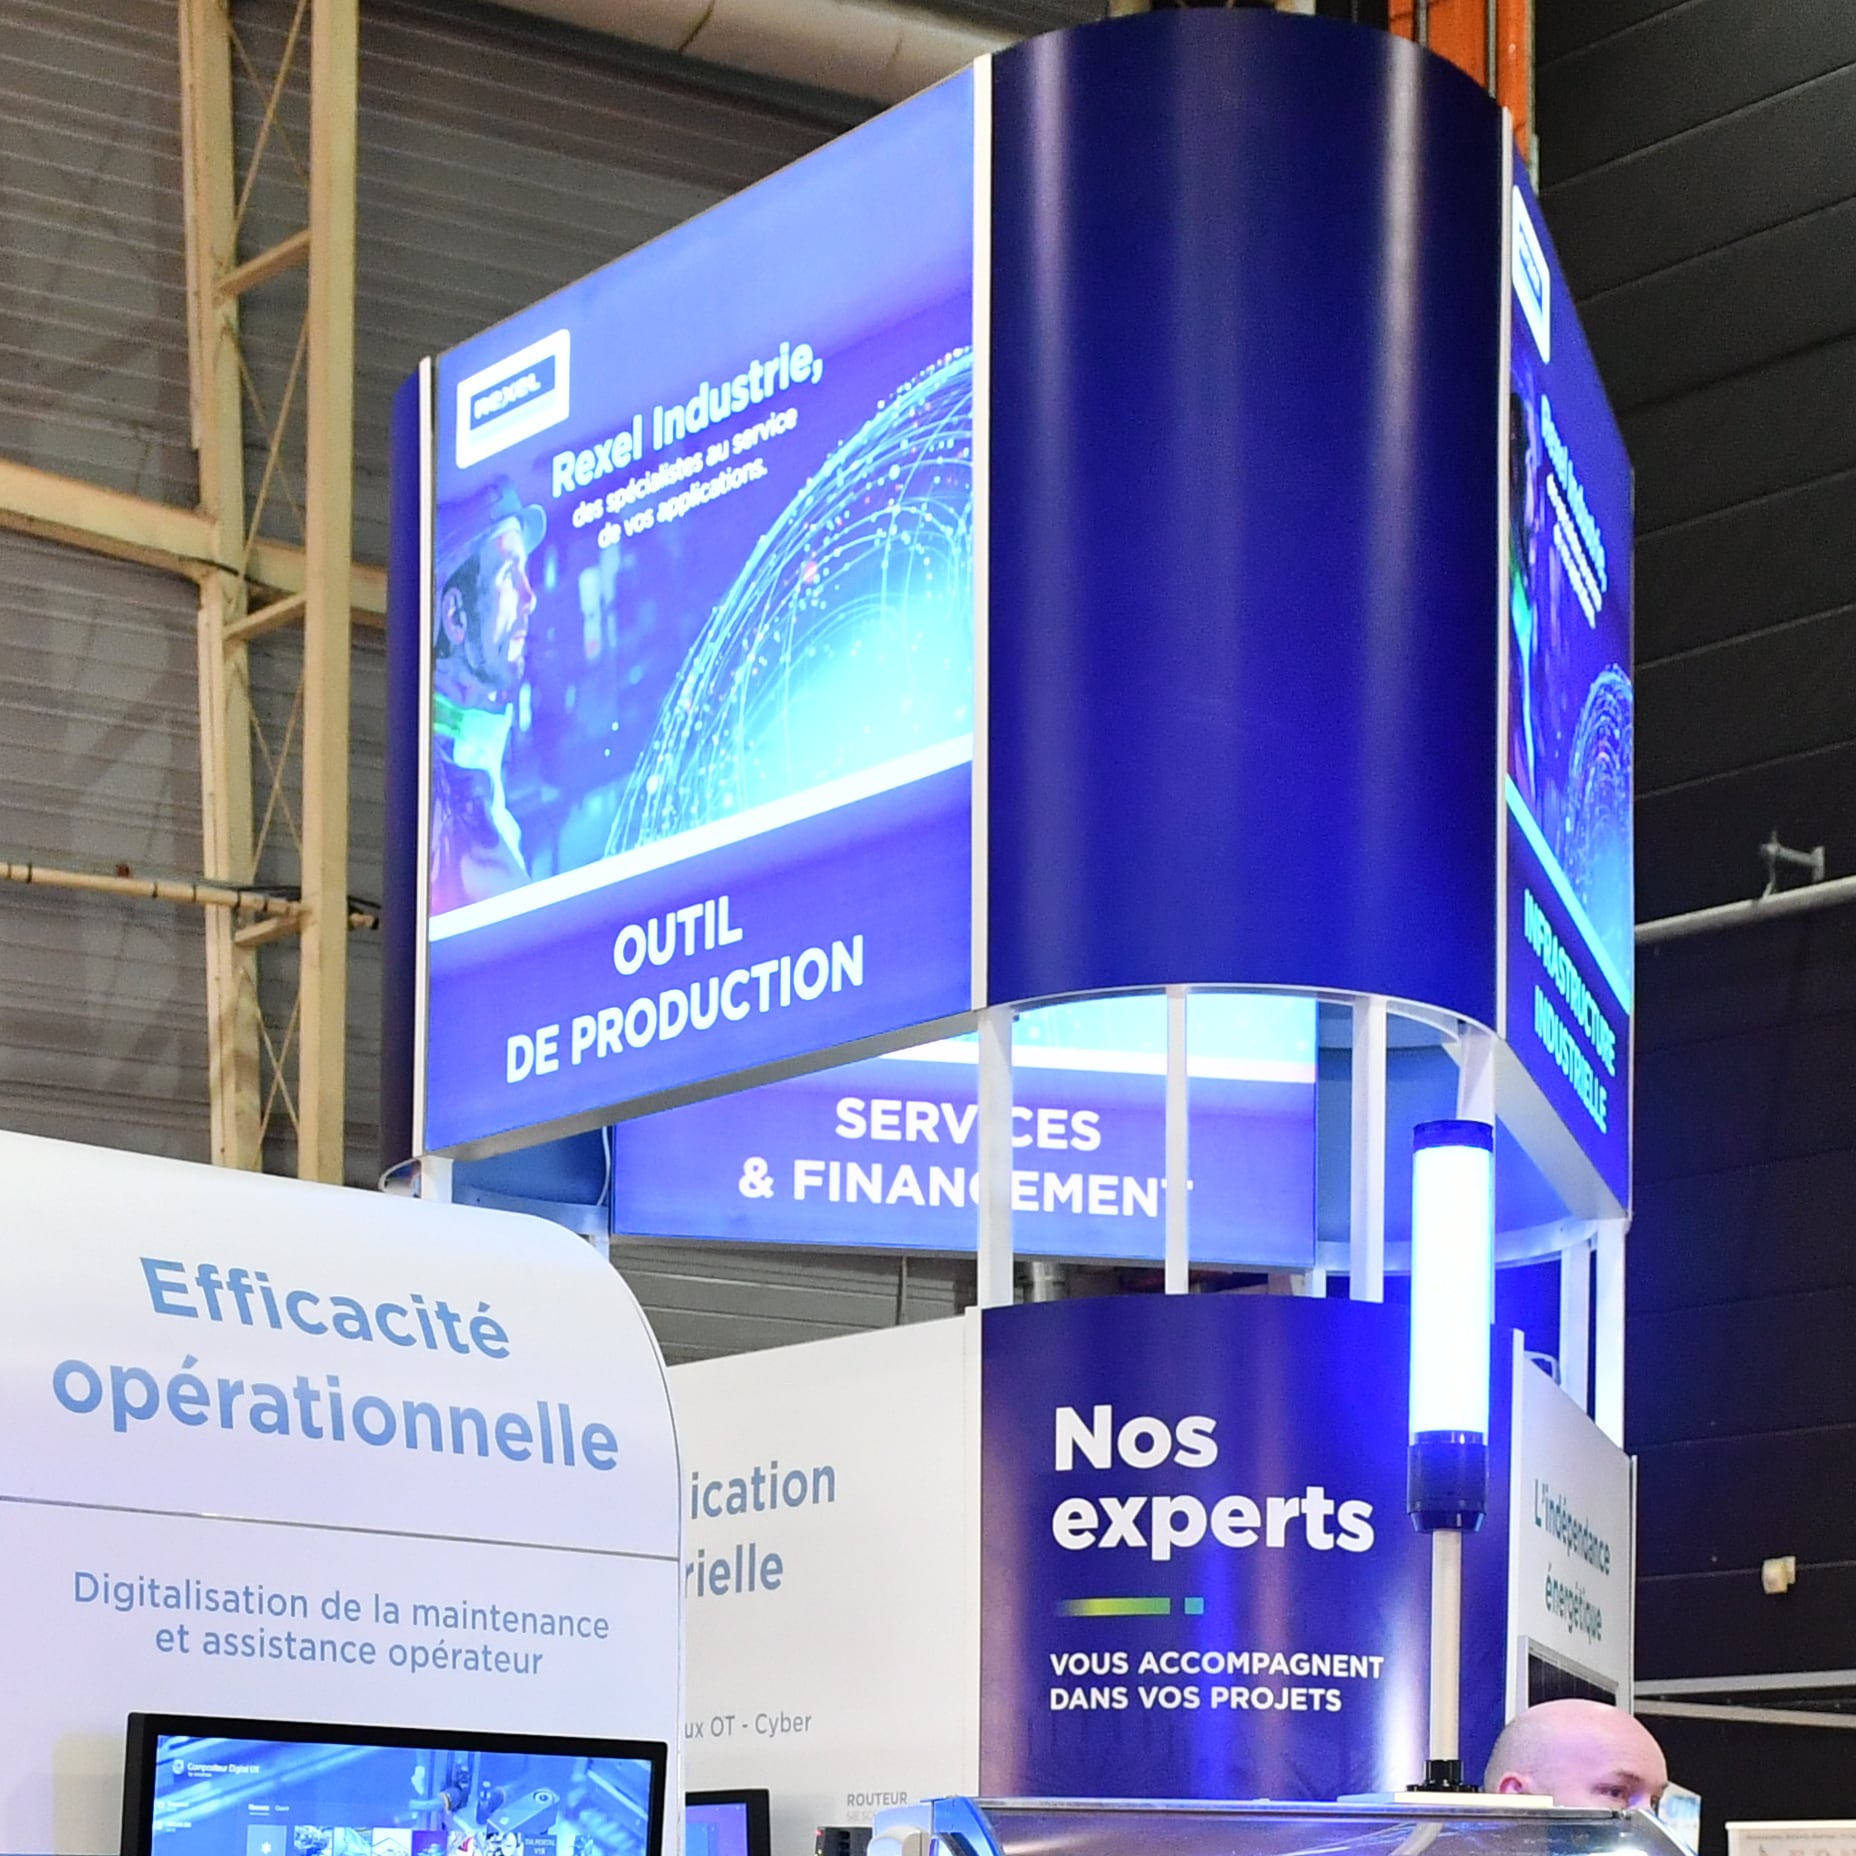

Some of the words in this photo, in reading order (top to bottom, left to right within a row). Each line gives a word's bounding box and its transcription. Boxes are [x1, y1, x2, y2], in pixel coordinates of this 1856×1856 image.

[552, 415, 642, 498] Rexel
[652, 341, 824, 450] Industrie,
[572, 496, 604, 528] des
[606, 452, 704, 515] spécialistes
[706, 440, 731, 467] au
[732, 408, 799, 455] service
[597, 521, 622, 549] de
[623, 506, 655, 538] vos
[656, 456, 768, 523] applications.
[613, 895, 744, 976] OUTIL
[506, 1023, 561, 1084] DE
[570, 934, 865, 1066] PRODUCTION
[1523, 887, 1616, 1078] INFRASTRUCTURE
[1534, 983, 1608, 1135] INDUSTRIELLE
[834, 1096, 1102, 1152] SERVCES
[737, 1156, 775, 1200] &
[138, 1255, 511, 1359] Efficacité
[51, 1353, 620, 1471] opérationnelle
[1054, 1403, 1219, 1472] Nos
[1051, 1485, 1376, 1561] experts
[74, 1570, 310, 1619] Digitalisation
[319, 1589, 362, 1623] de
[373, 1592, 401, 1625] la
[411, 1597, 611, 1640] maintenance
[1545, 1562, 1603, 1645] énergétique
[155, 1624, 191, 1655] et
[202, 1625, 378, 1667] assistance
[387, 1638, 544, 1676] opérateur
[1050, 1651, 1129, 1676] VOUS
[1137, 1651, 1385, 1680] ACCOMPAGNENT
[710, 1714, 737, 1738] OT
[754, 1711, 813, 1738] Cyber
[1050, 1686, 1129, 1711] DANS
[1138, 1686, 1201, 1710] VOS
[1210, 1686, 1342, 1712] PROJETS
[846, 1791, 908, 1807] ROUTEUR
